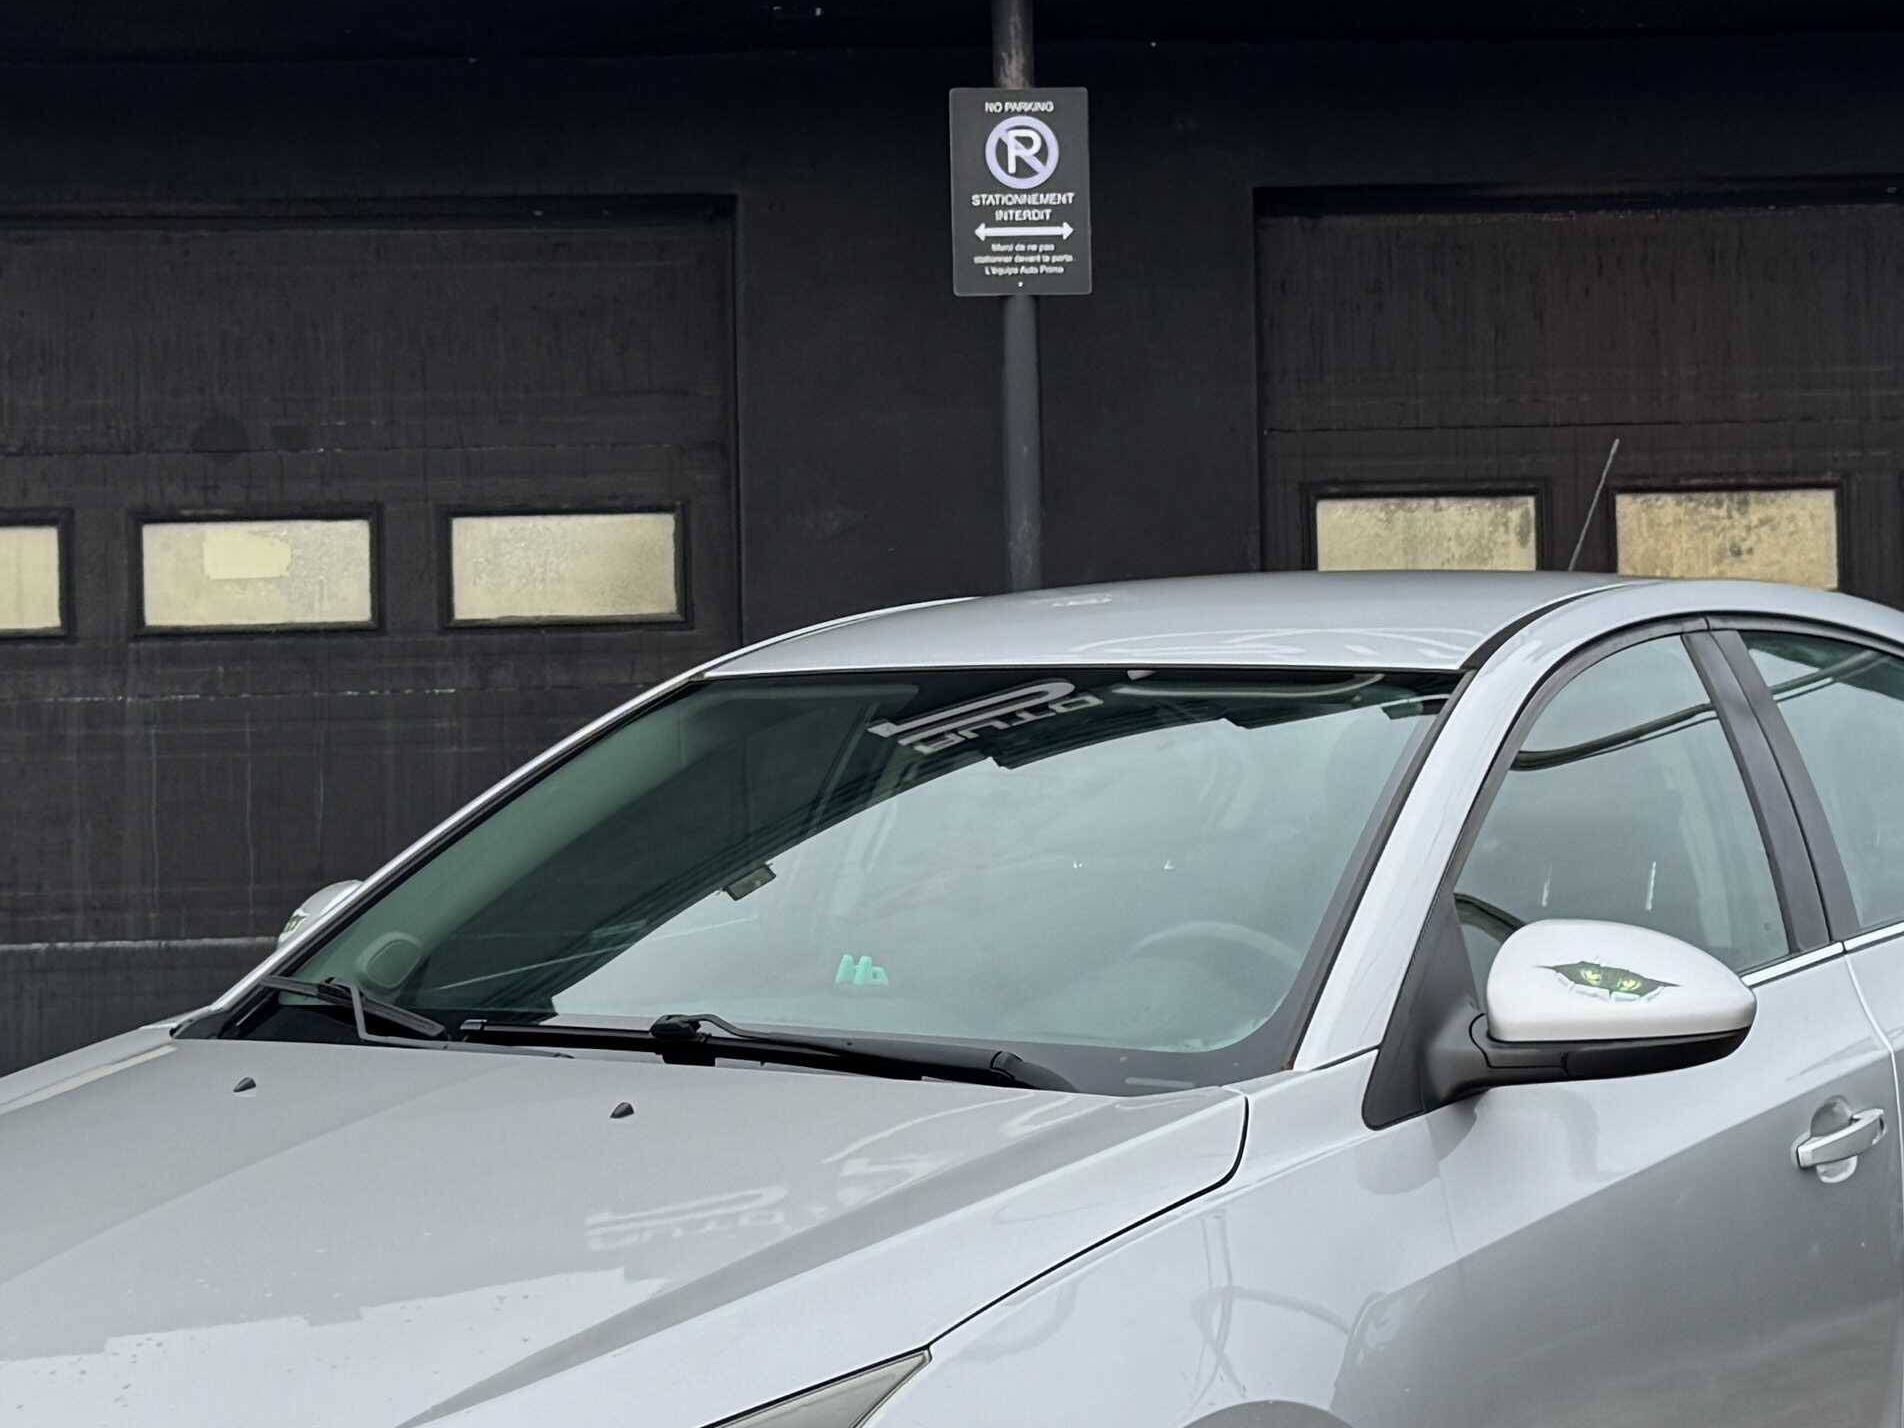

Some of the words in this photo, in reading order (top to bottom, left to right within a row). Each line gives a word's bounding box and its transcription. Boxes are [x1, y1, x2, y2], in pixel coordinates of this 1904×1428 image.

[984, 101, 1003, 113] NO
[1004, 101, 1055, 113] PARKING
[971, 192, 1075, 206] STATIONNEMENT
[995, 209, 1052, 221] INTERDIT
